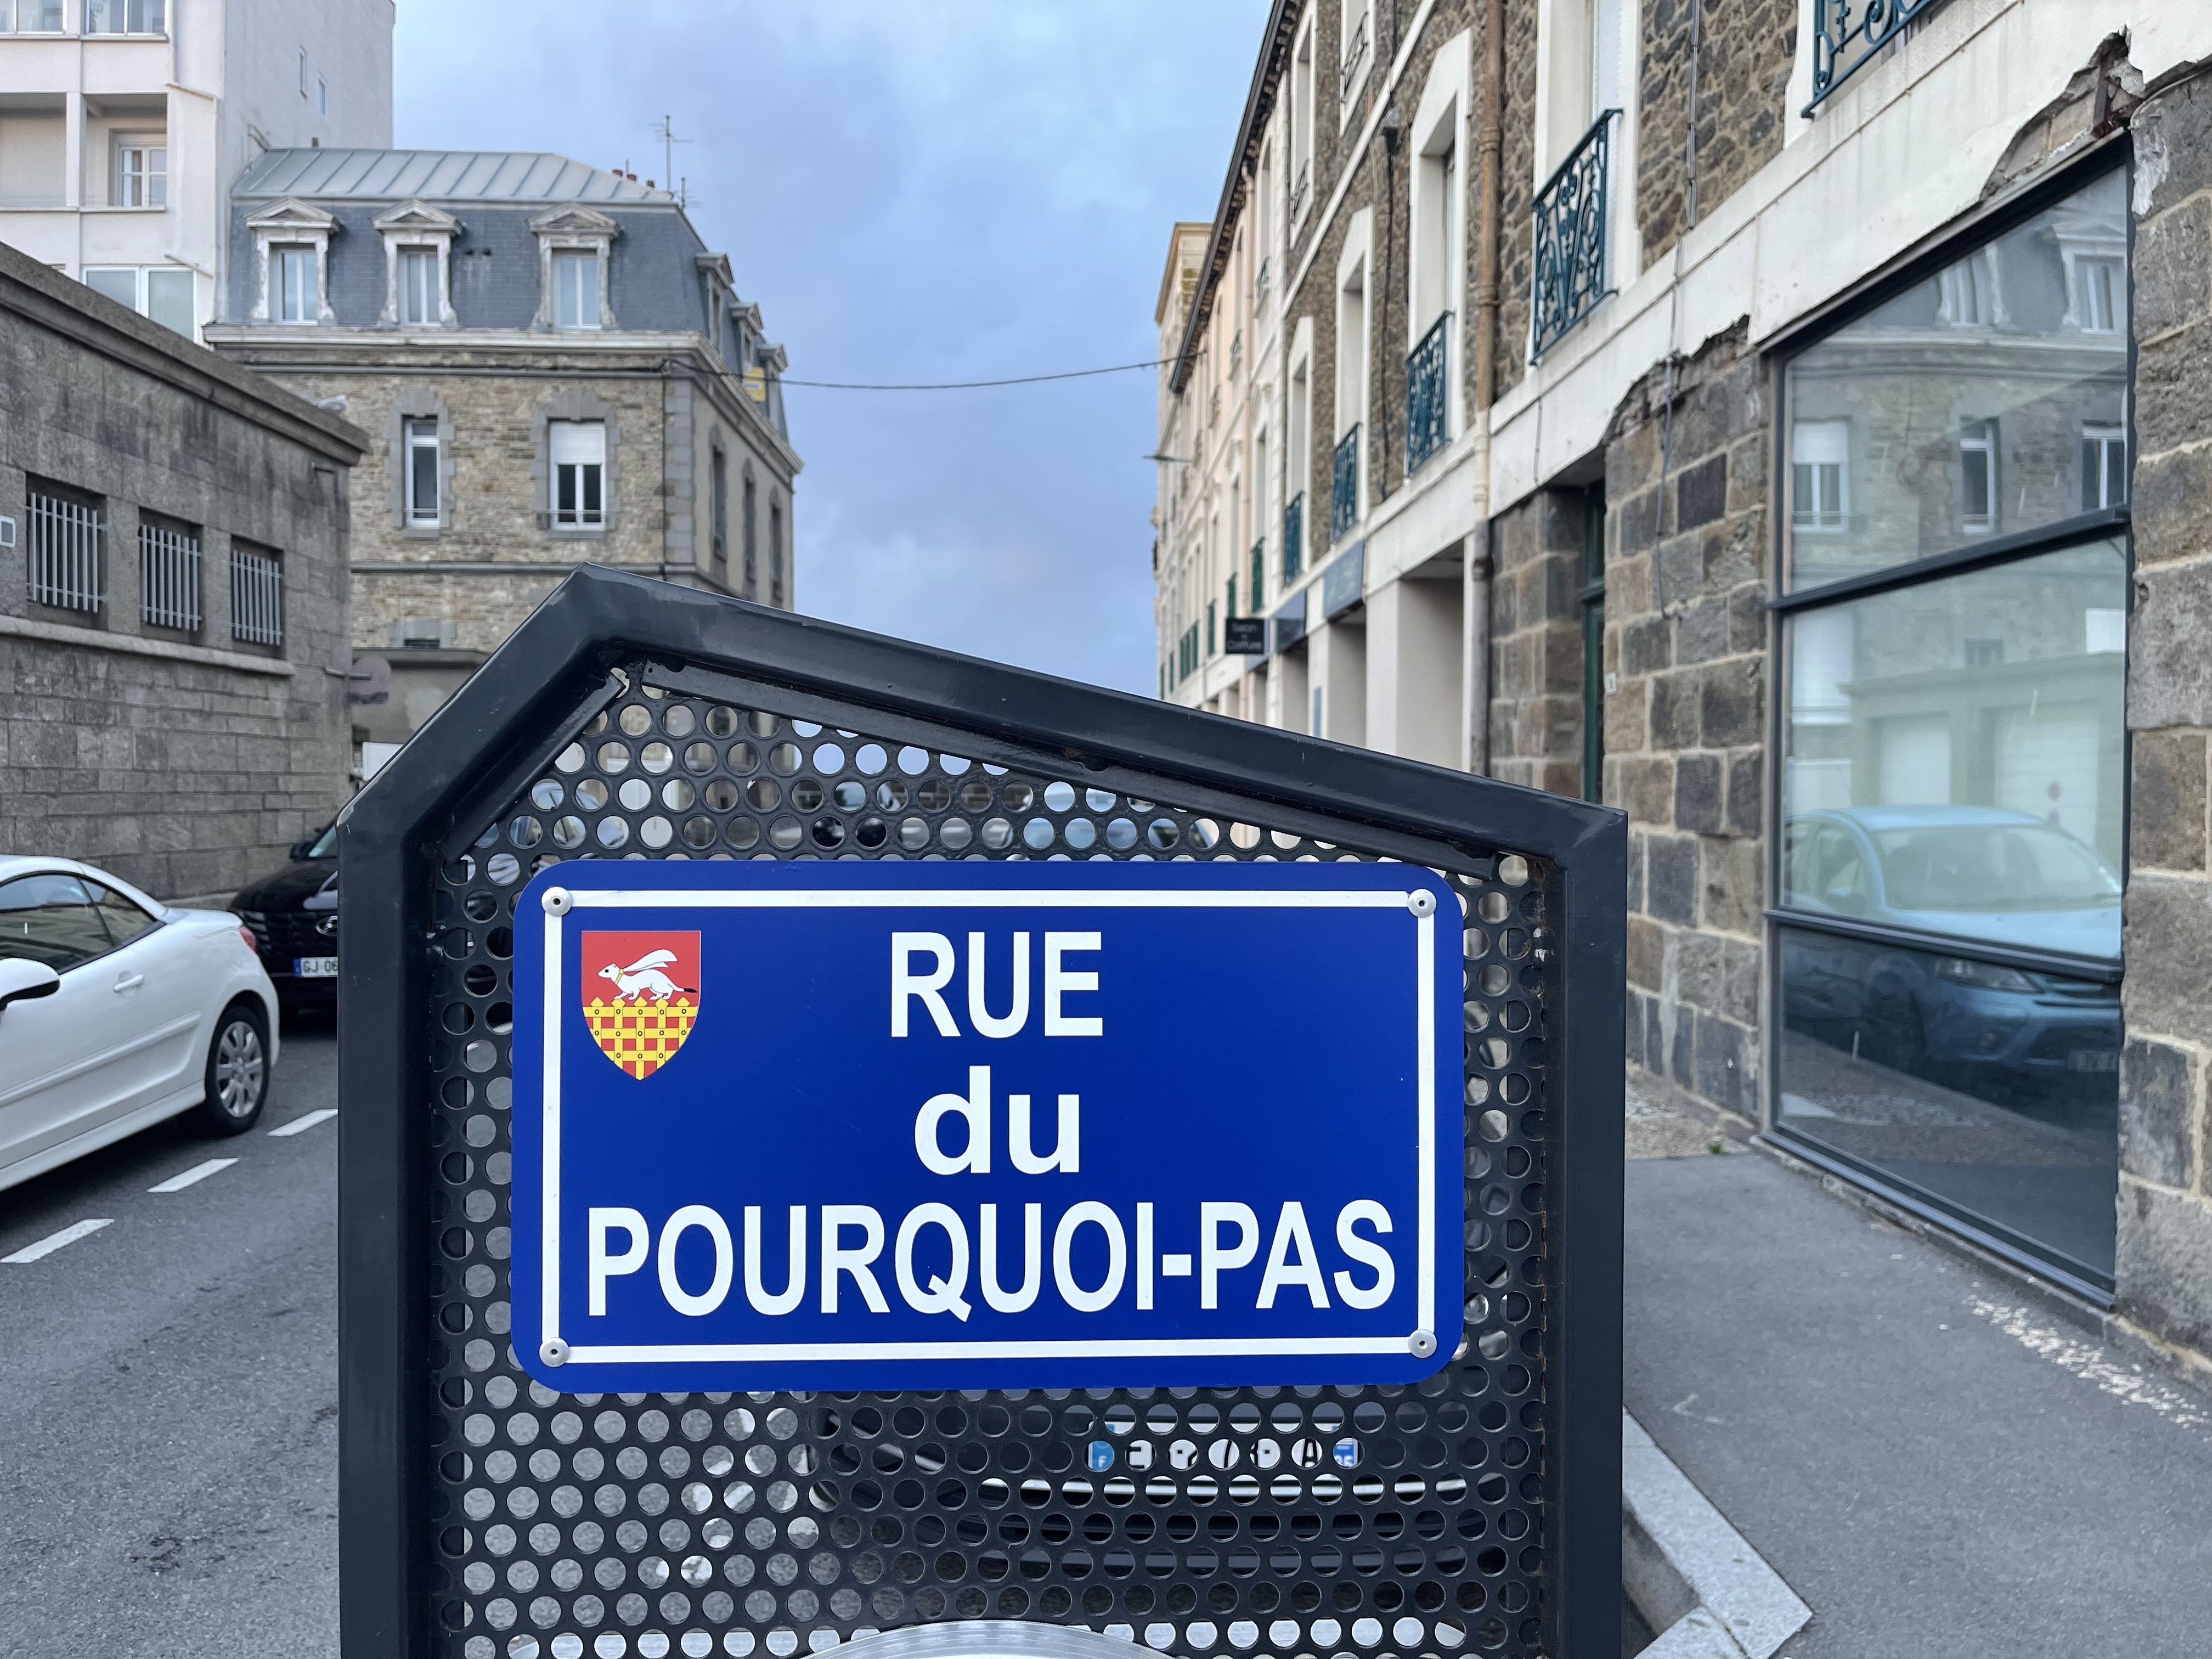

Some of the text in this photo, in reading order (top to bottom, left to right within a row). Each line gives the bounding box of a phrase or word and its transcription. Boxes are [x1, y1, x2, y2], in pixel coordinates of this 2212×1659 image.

[891, 930, 1103, 1039] RUE
[915, 1065, 1080, 1175] du
[588, 1199, 1395, 1322] POURQUOI-PAS
